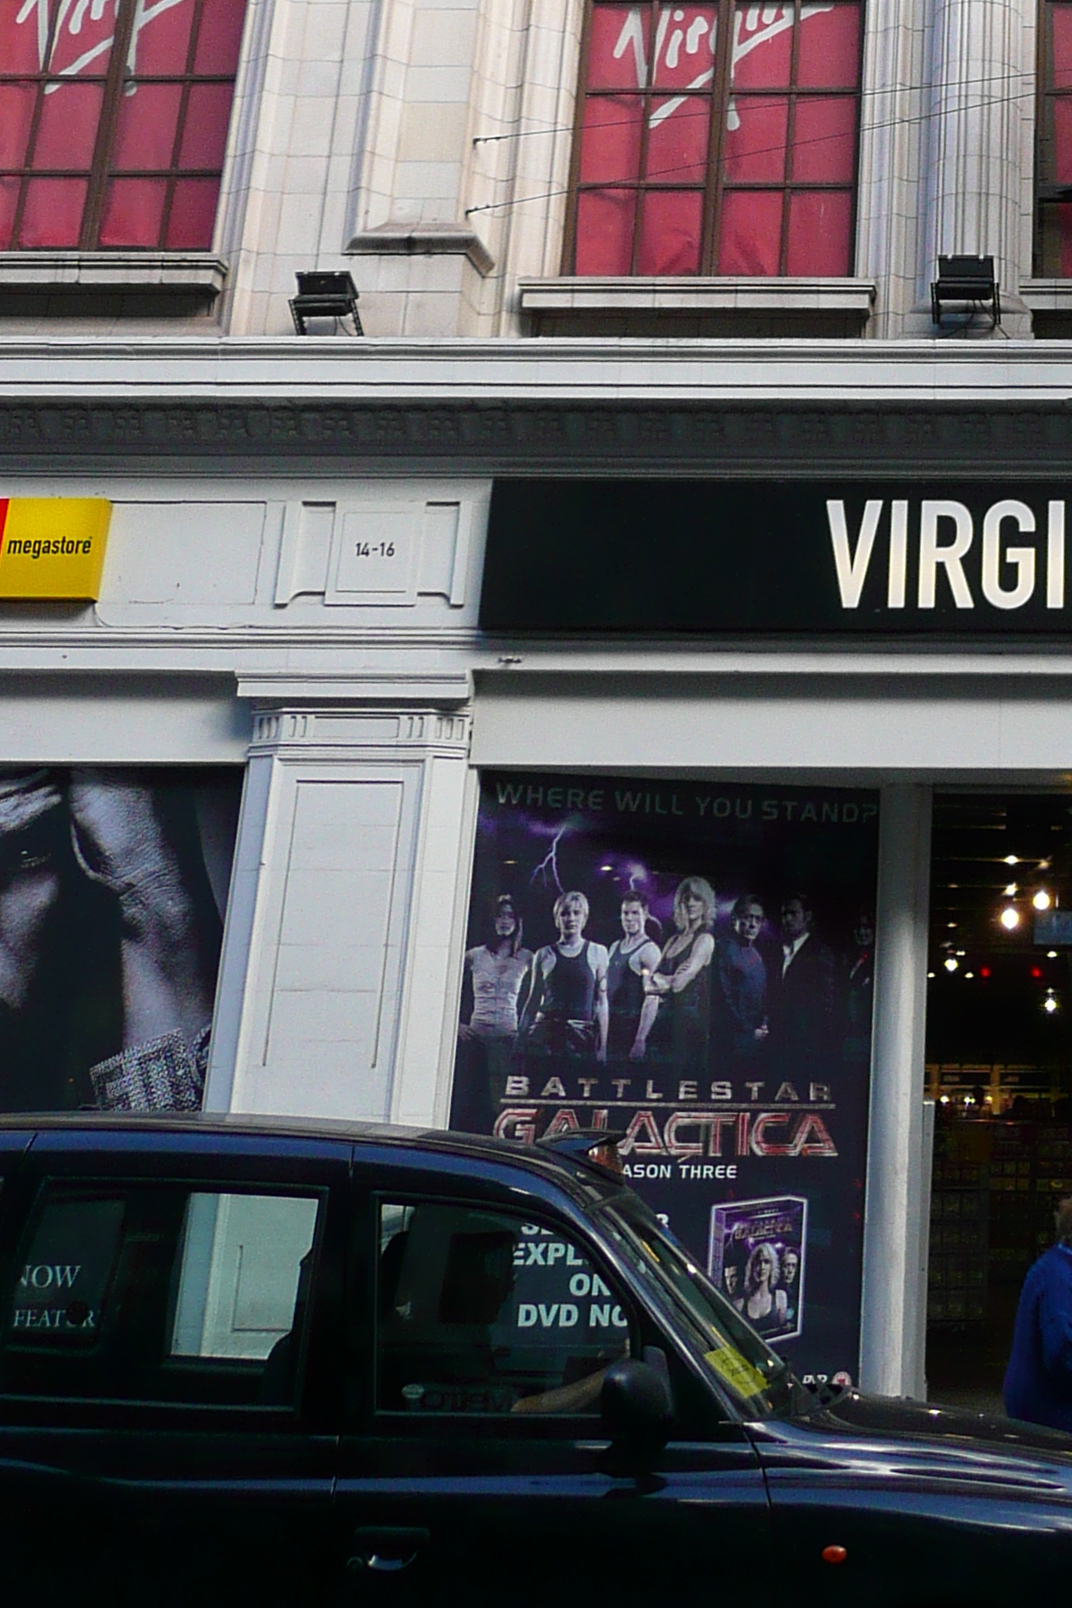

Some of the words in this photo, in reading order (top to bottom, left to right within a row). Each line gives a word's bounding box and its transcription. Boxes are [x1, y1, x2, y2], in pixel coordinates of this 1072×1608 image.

[7, 535, 92, 559] megastore
[354, 541, 396, 558] 14-16
[496, 780, 605, 810] WHERE
[615, 789, 685, 817] WILL
[695, 796, 753, 820] YOU
[760, 798, 880, 825] STAND?
[505, 1075, 832, 1101] BATTLESTAR
[621, 1163, 671, 1179] ASON
[679, 1164, 738, 1180] THREE
[512, 1242, 590, 1266] EXPL
[13, 1309, 97, 1328] FEATR
[517, 1303, 579, 1328] DVD
[589, 1303, 628, 1328] NO
